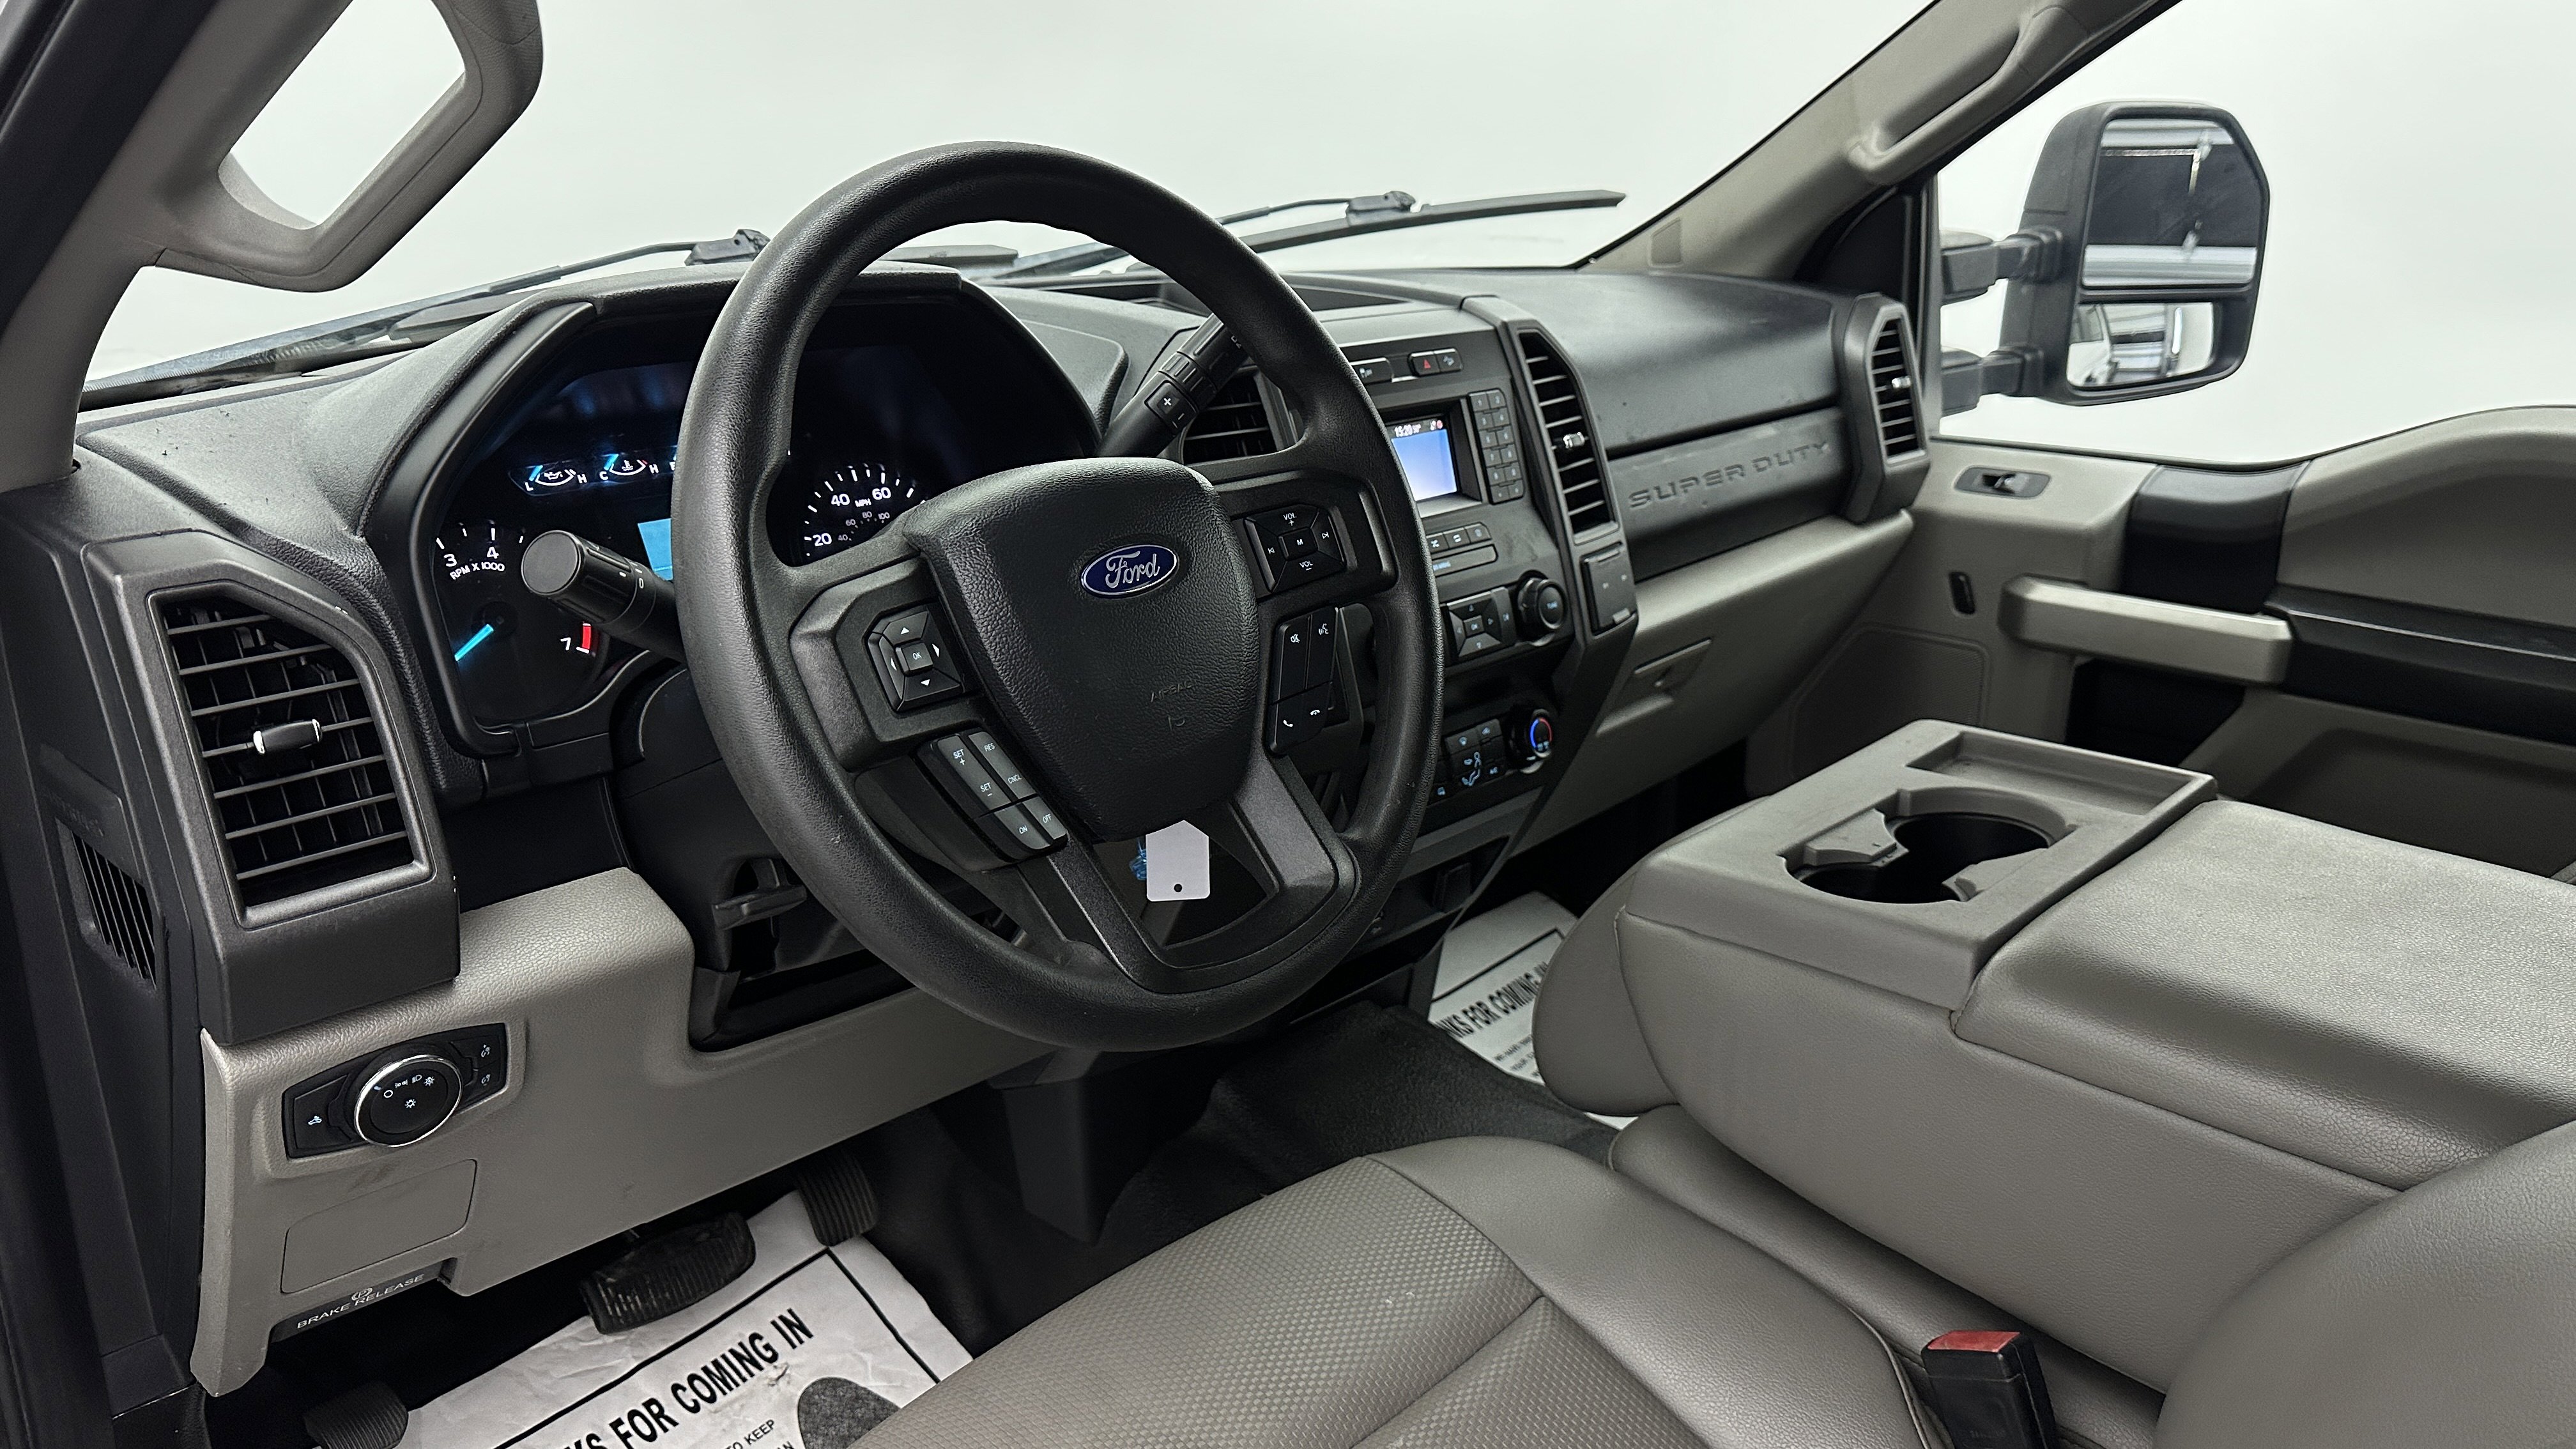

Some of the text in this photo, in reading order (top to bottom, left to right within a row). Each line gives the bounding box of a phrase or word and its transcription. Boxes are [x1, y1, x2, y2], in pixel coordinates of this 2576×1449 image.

[599, 464, 659, 480] C H
[1629, 441, 1829, 509] SUPER DUTY
[525, 473, 588, 491] L H
[831, 493, 850, 506] 40
[871, 487, 891, 500] 60
[854, 498, 871, 507] MPH
[1283, 512, 1296, 521] VOL
[812, 532, 832, 547] 20
[486, 547, 499, 559] 4
[443, 554, 457, 567] 3
[449, 567, 471, 580] RPM
[481, 562, 505, 572] 1000
[1105, 550, 1161, 588] Ford
[560, 637, 571, 650] 7
[912, 652, 922, 660] OK
[984, 742, 995, 752] RES
[953, 749, 965, 759] SET
[1008, 774, 1022, 785] CNCL
[980, 782, 992, 793] SET
[1042, 813, 1052, 824] OFF
[1019, 825, 1028, 834] ON
[1461, 1000, 1502, 1030] FOR
[297, 1274, 425, 1328] BRAKE RELEASE
[609, 1308, 813, 1449] FOR COMING IN
[744, 1419, 775, 1445] KEEP
